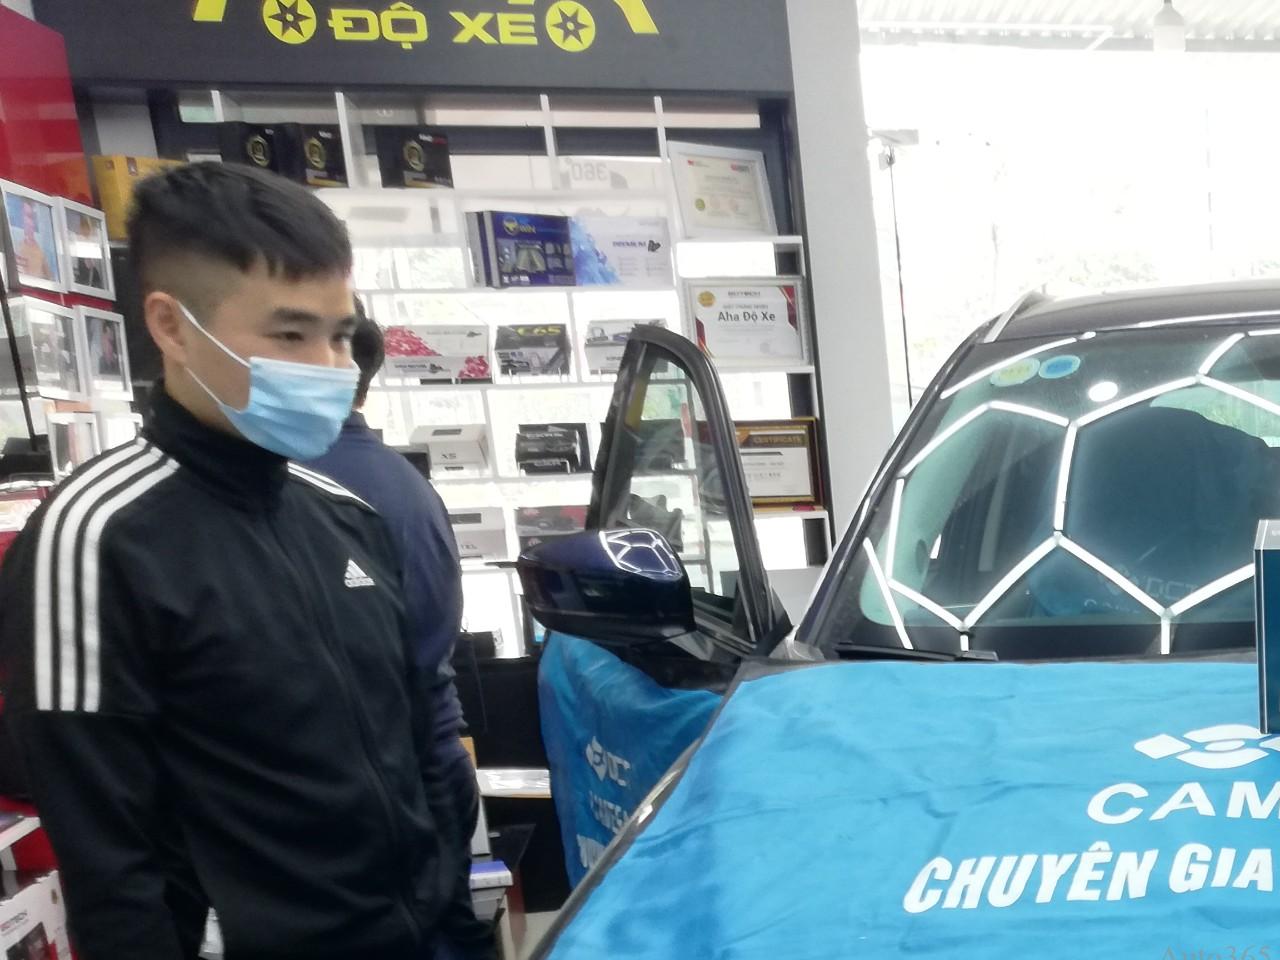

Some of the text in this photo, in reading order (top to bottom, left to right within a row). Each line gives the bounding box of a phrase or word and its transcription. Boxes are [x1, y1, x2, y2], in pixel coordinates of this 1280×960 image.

[329, 3, 429, 49] ĐỘ
[718, 310, 776, 324] Aha Độ Xe
[902, 840, 1160, 915] CHUYÊN
[1168, 842, 1275, 894] GIA
